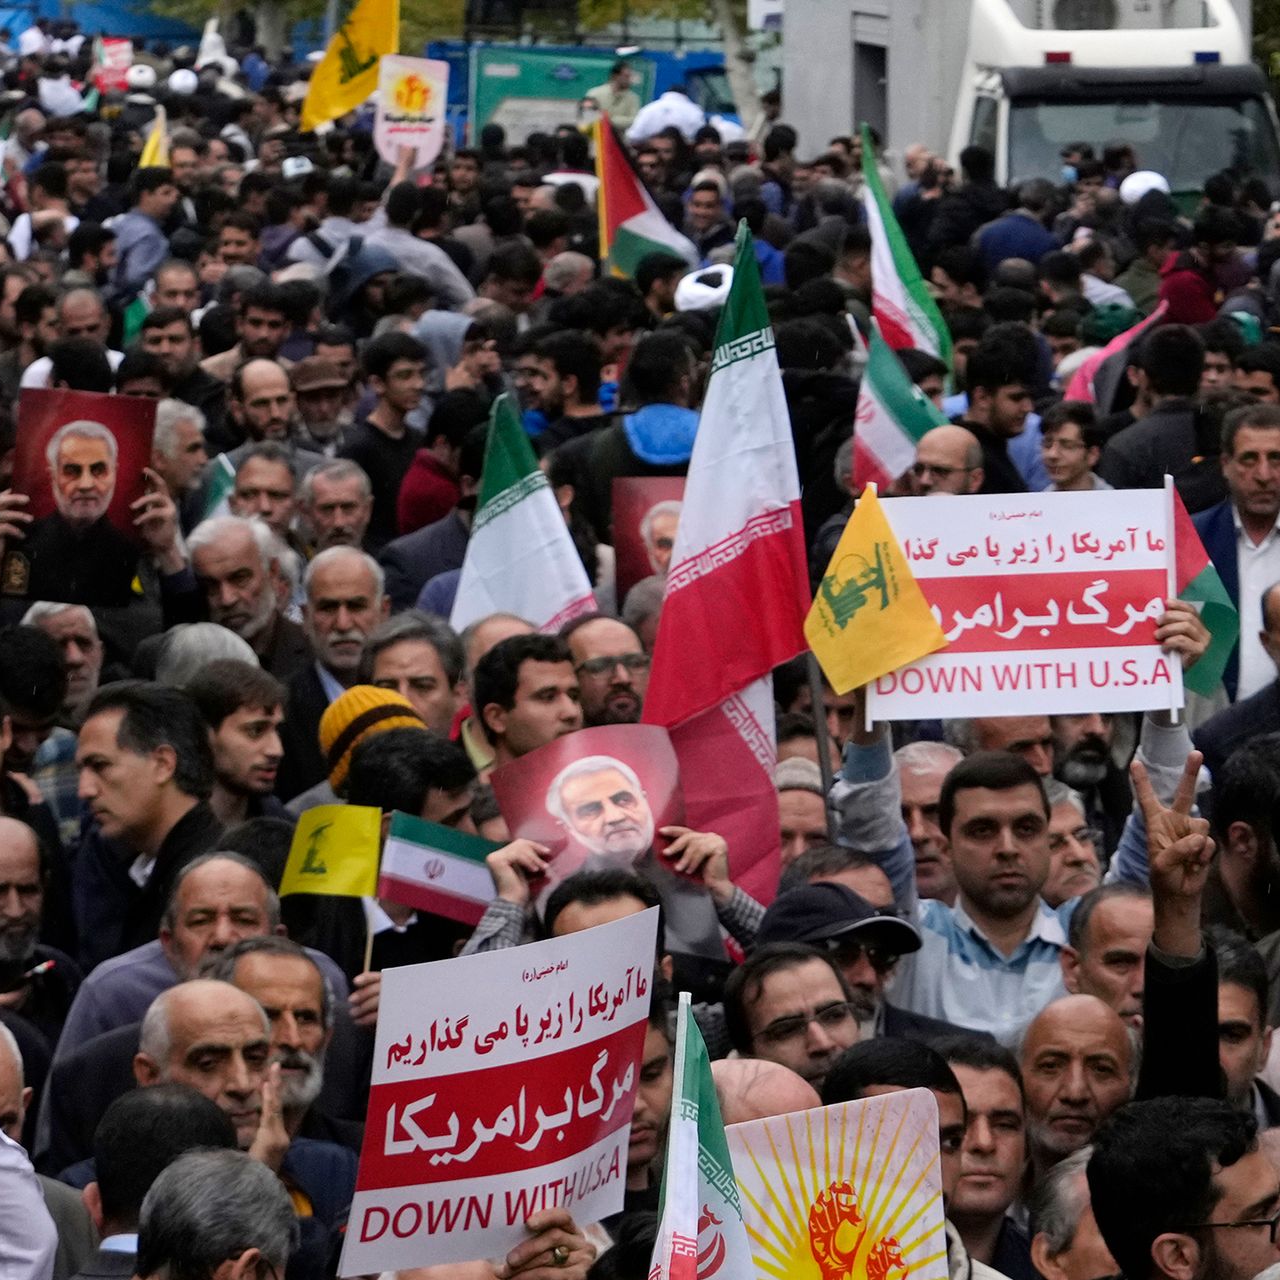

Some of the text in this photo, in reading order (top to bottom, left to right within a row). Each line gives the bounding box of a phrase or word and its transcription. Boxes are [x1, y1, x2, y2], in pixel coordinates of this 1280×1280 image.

[985, 536, 1000, 566] پا
[1008, 540, 1040, 564] زیر
[1047, 533, 1065, 563] را
[1072, 528, 1137, 560] آمریکا
[1146, 530, 1165, 551] ما
[1066, 579, 1165, 635] مرگ
[876, 658, 1172, 695] DOWN WITH U.S.A
[387, 966, 647, 1069] ما آمریکا را زیر پا می گذاریم
[577, 1048, 635, 1122] مرگ
[360, 1193, 494, 1243] DOWN
[504, 1172, 578, 1226] WITH
